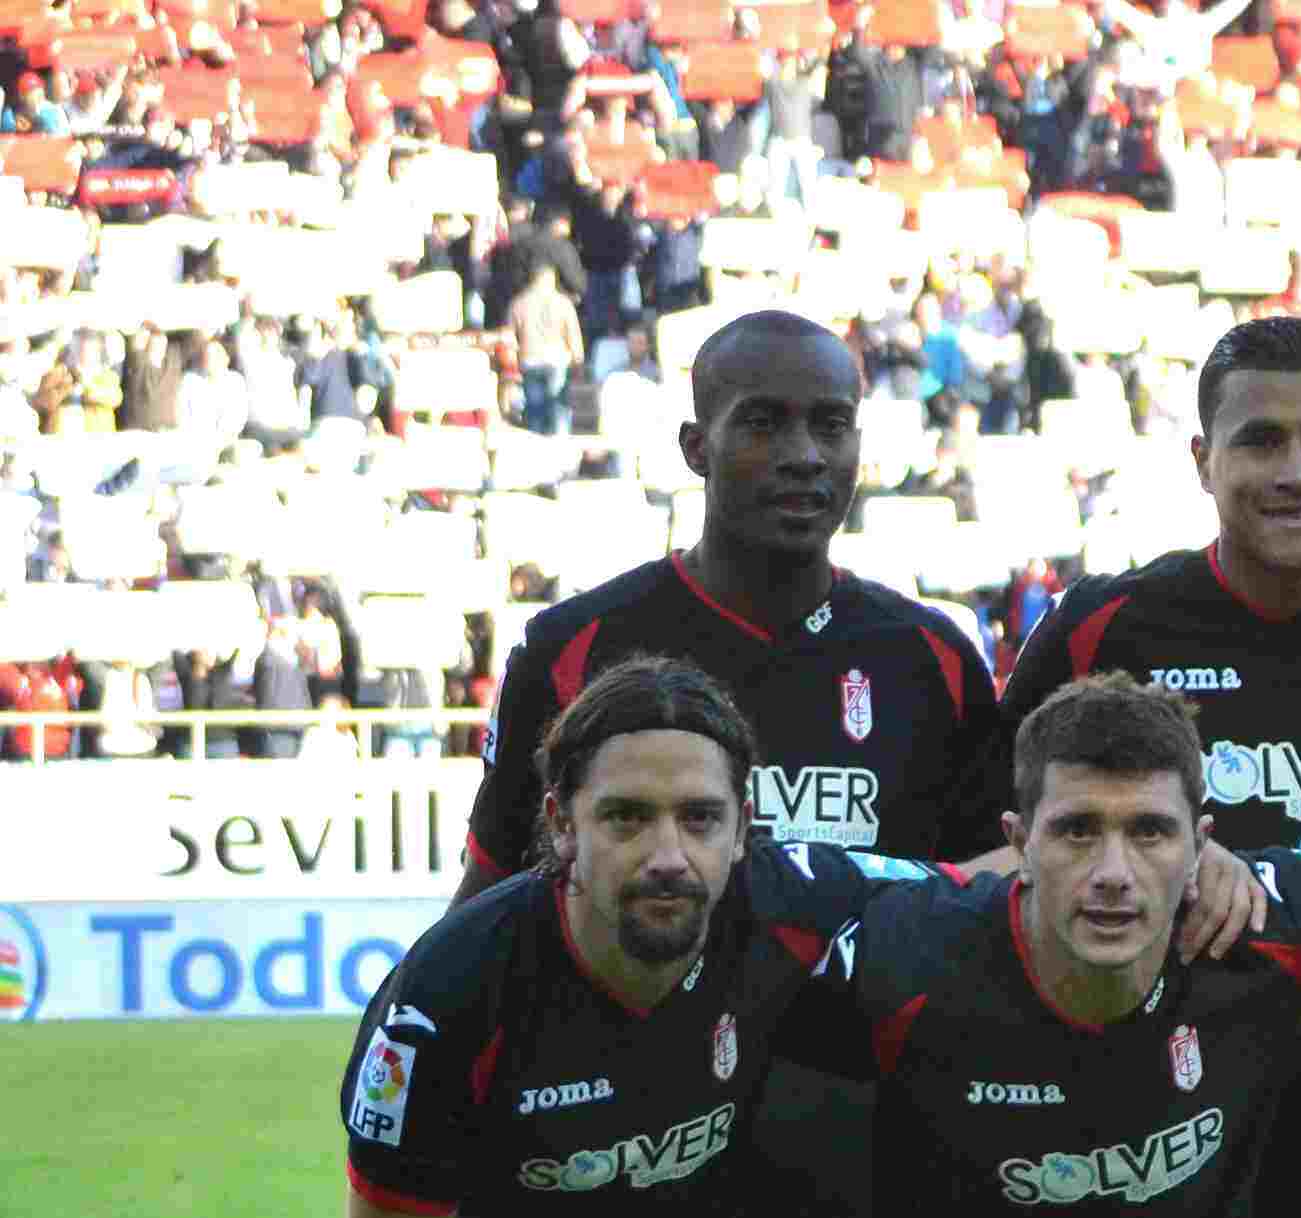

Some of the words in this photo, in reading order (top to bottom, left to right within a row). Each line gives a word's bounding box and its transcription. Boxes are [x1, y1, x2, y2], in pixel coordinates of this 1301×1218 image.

[751, 769, 877, 825] LVER
[518, 1077, 614, 1114] Joma
[967, 1080, 1066, 1104] Joma
[523, 1104, 734, 1189] SOLVER
[1003, 1111, 1222, 1201] SOLVER
